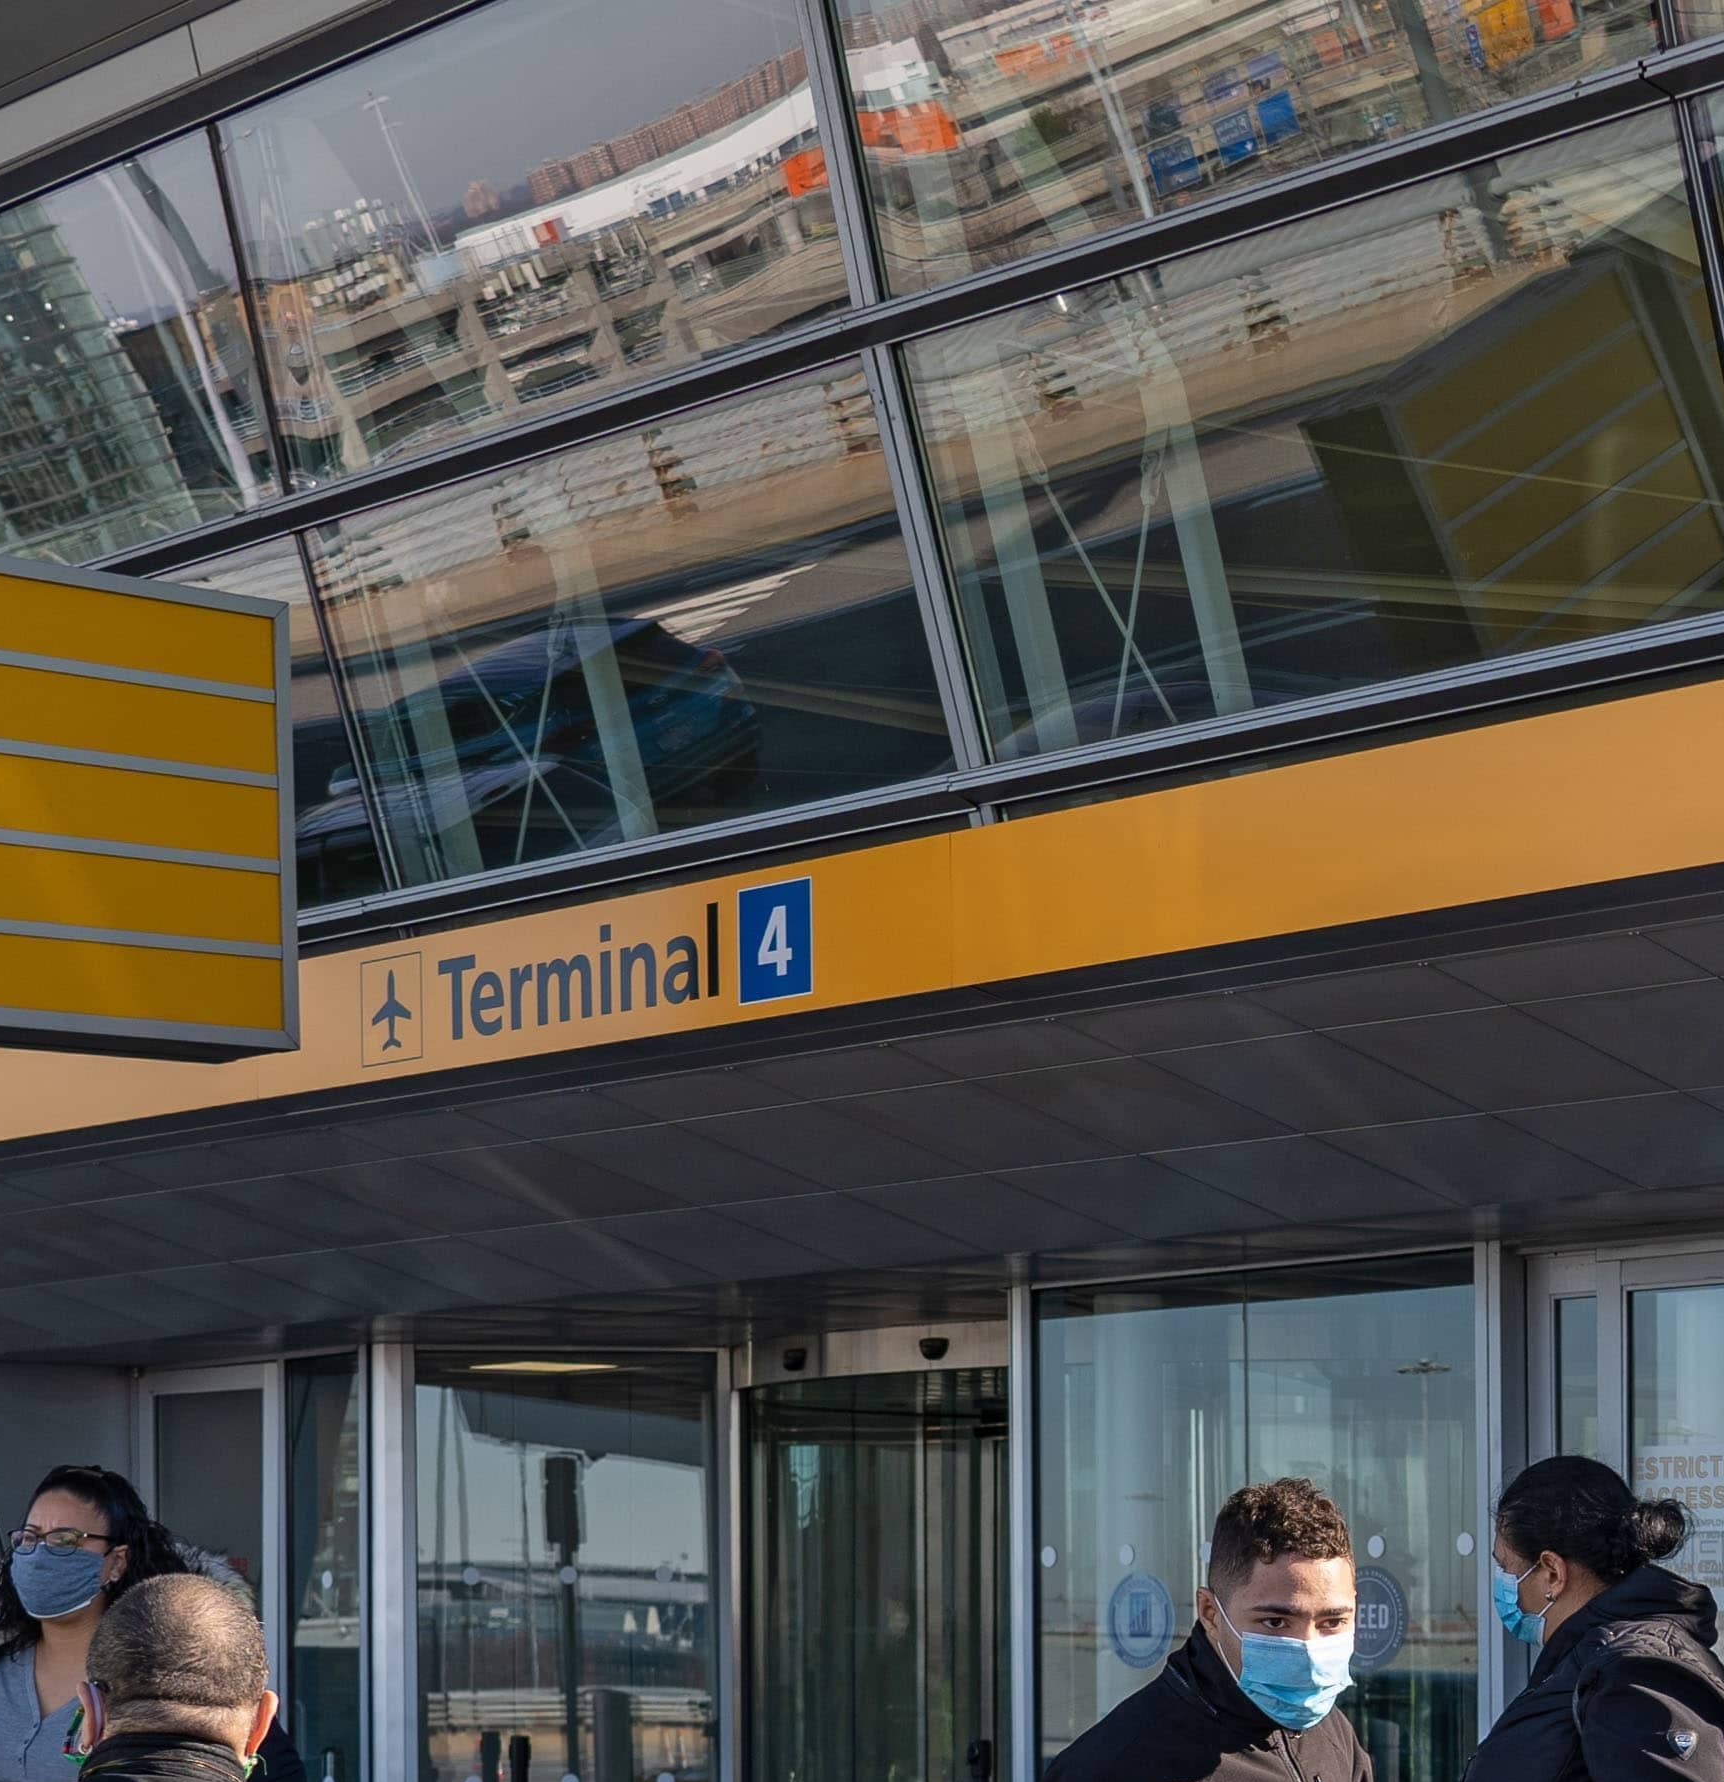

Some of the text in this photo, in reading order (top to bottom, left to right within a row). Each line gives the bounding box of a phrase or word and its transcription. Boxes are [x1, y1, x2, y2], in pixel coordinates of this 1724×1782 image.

[438, 901, 793, 1041] Terminal 4
[1357, 1603, 1389, 1630] EED
